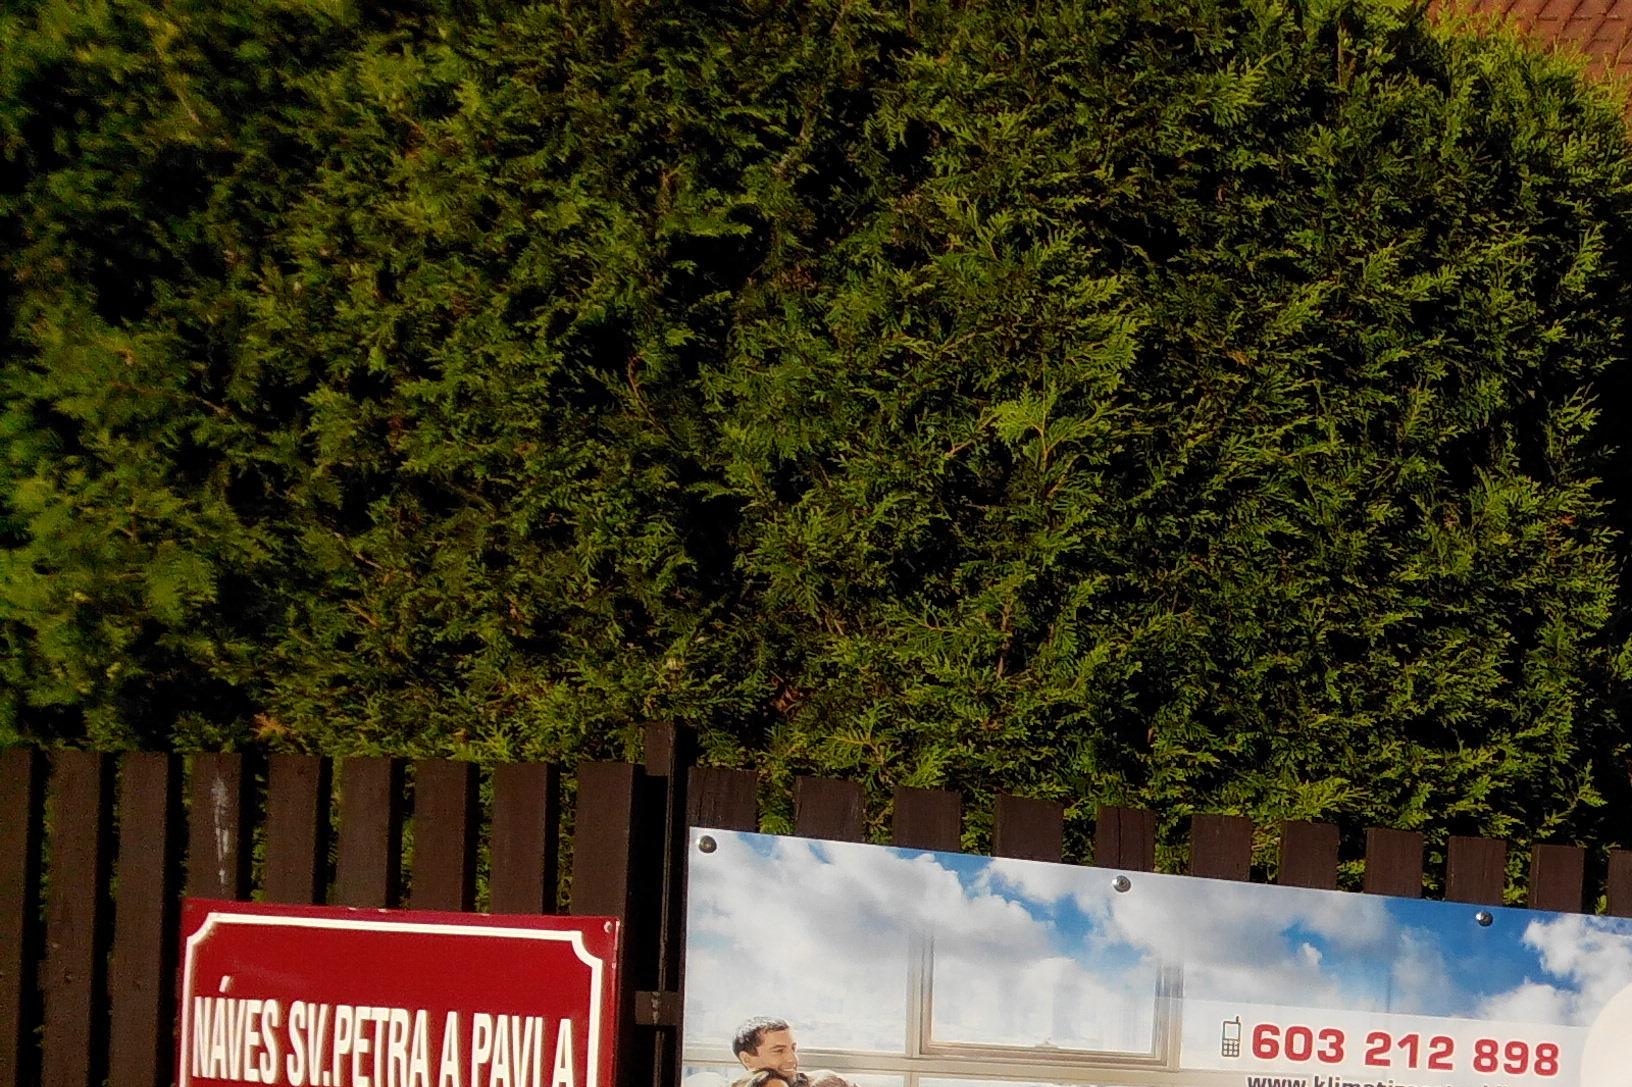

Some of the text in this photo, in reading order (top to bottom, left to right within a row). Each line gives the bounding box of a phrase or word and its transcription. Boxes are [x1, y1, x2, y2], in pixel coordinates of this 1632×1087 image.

[193, 976, 280, 1084] NÁVES
[1253, 1024, 1558, 1076] 603 212 898
